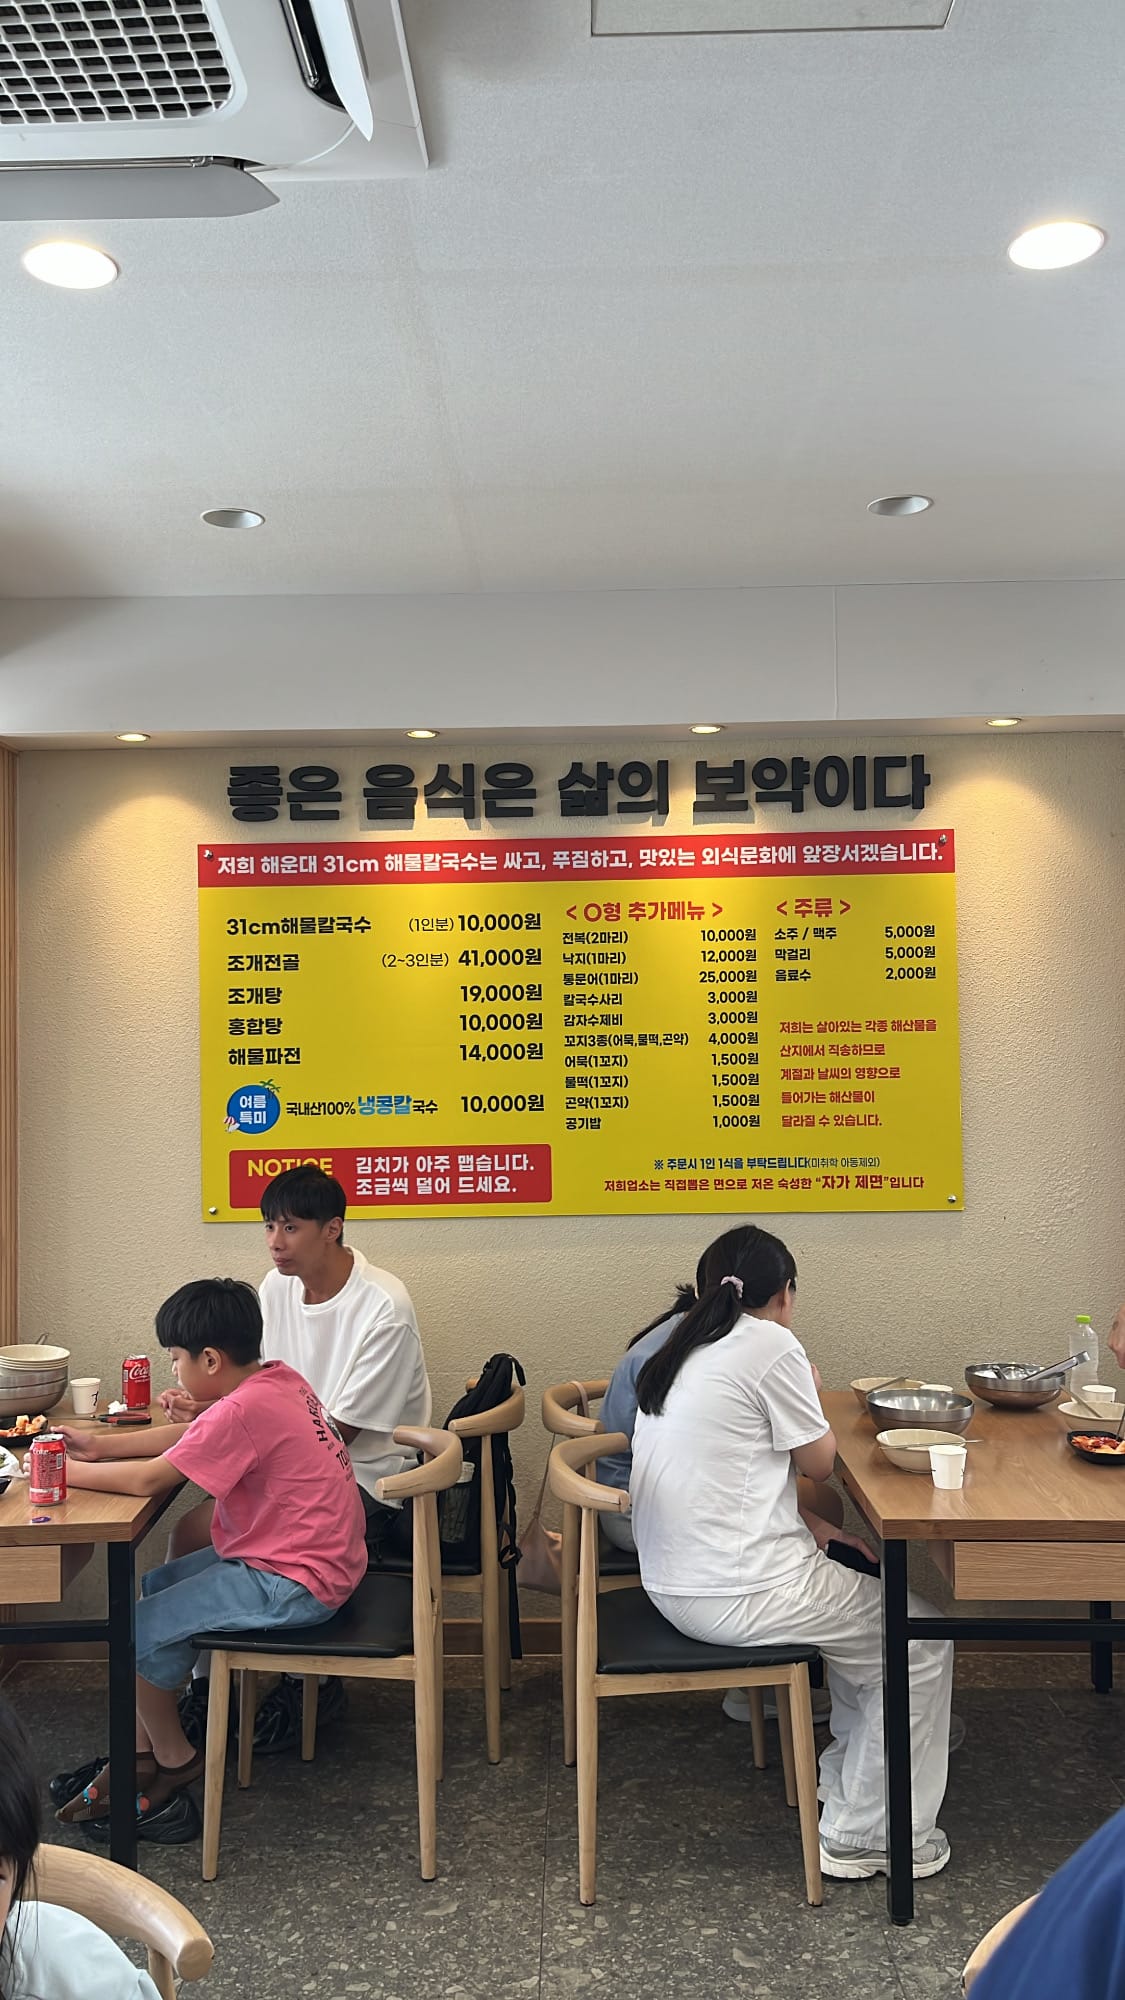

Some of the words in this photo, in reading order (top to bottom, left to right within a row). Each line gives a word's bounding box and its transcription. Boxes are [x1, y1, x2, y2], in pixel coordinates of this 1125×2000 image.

[227, 764, 342, 822] 좋은
[363, 762, 537, 820] 음식은
[558, 760, 671, 817] 삶의
[693, 754, 931, 813] 보약이다
[218, 856, 255, 875] 저희
[261, 854, 317, 874] 해운대
[323, 855, 379, 873] 31cm
[384, 852, 498, 872] 해물칼국수는
[504, 851, 547, 871] 싸고,
[552, 849, 633, 869] 푸짐하고,
[639, 847, 695, 867] 맛있는
[701, 845, 796, 866] 외식문화에
[803, 842, 944, 865] 앞장서겠습니다.
[628, 901, 706, 921] 추가메뉴
[794, 898, 833, 918] 주류
[226, 916, 372, 936] 31cm해물칼국수
[408, 917, 455, 933] (1인분)
[458, 913, 542, 932] 10,000원
[562, 931, 628, 945] 전복(2마리)
[701, 929, 757, 943] 10,000원
[774, 927, 798, 941] 소주
[813, 927, 837, 940] 맥주
[885, 925, 936, 939] 5,000원
[227, 953, 300, 972] 조개전골
[381, 953, 450, 968] (2~3인분)
[458, 948, 543, 967] 41,000원
[562, 951, 626, 965] 낙지(1마리)
[701, 949, 757, 963] 12,000원
[775, 948, 811, 961] 막걸리
[885, 946, 936, 960] 5,000원
[563, 972, 639, 985] 통문어(1마리)
[699, 969, 757, 984] 25,000원
[775, 969, 811, 982] 음료수
[885, 966, 936, 981] 2,000원
[227, 987, 282, 1005] 조개탕
[460, 983, 543, 1003] 19,000원
[563, 993, 623, 1006] 칼국수사리
[707, 990, 758, 1005] 3,000원
[228, 1017, 282, 1036] 홍합탕
[460, 1013, 543, 1032] 10,000원
[564, 1014, 623, 1027] 감자수제비
[708, 1011, 758, 1025] 3,000원
[779, 1021, 813, 1034] 저희는
[816, 1020, 862, 1033] 살아있는
[865, 1020, 888, 1033] 각종
[891, 1019, 937, 1032] 해산물을
[708, 1032, 759, 1046] 4,000원
[228, 1048, 301, 1066] 해물파전
[460, 1042, 544, 1062] 14,000원
[780, 1045, 825, 1057] 산지에서
[828, 1044, 886, 1057] 직송하므로
[711, 1053, 759, 1067] 1,500원
[712, 1073, 760, 1087] 1,500원
[780, 1068, 814, 1081] 계절과
[817, 1067, 851, 1080] 날씨의
[855, 1067, 901, 1079] 영향으로
[239, 1095, 266, 1109] 여름
[461, 1095, 545, 1114] 10,000원
[712, 1094, 760, 1108] 1,500원
[781, 1092, 826, 1104] 들어가는
[829, 1091, 875, 1103] 해산물이
[239, 1110, 266, 1125] 특미
[566, 1117, 601, 1130] 공기밥
[713, 1114, 760, 1129] 1,000원
[781, 1115, 816, 1127] 달라질
[818, 1115, 830, 1127] 수
[833, 1114, 882, 1127] 있습니다.
[356, 1156, 409, 1174] 김치가
[416, 1155, 451, 1173] 아주
[458, 1153, 535, 1172] 맵습니다.
[667, 1158, 697, 1170] 주문시
[700, 1158, 715, 1169] 1인
[356, 1177, 409, 1195] 조금씩
[416, 1176, 450, 1194] 덜어
[458, 1174, 517, 1193] 드세요.
[604, 1179, 660, 1192] 저희업소는
[713, 1178, 747, 1190] 면으로
[751, 1178, 774, 1190] 저온
[778, 1178, 812, 1190] 숙성한
